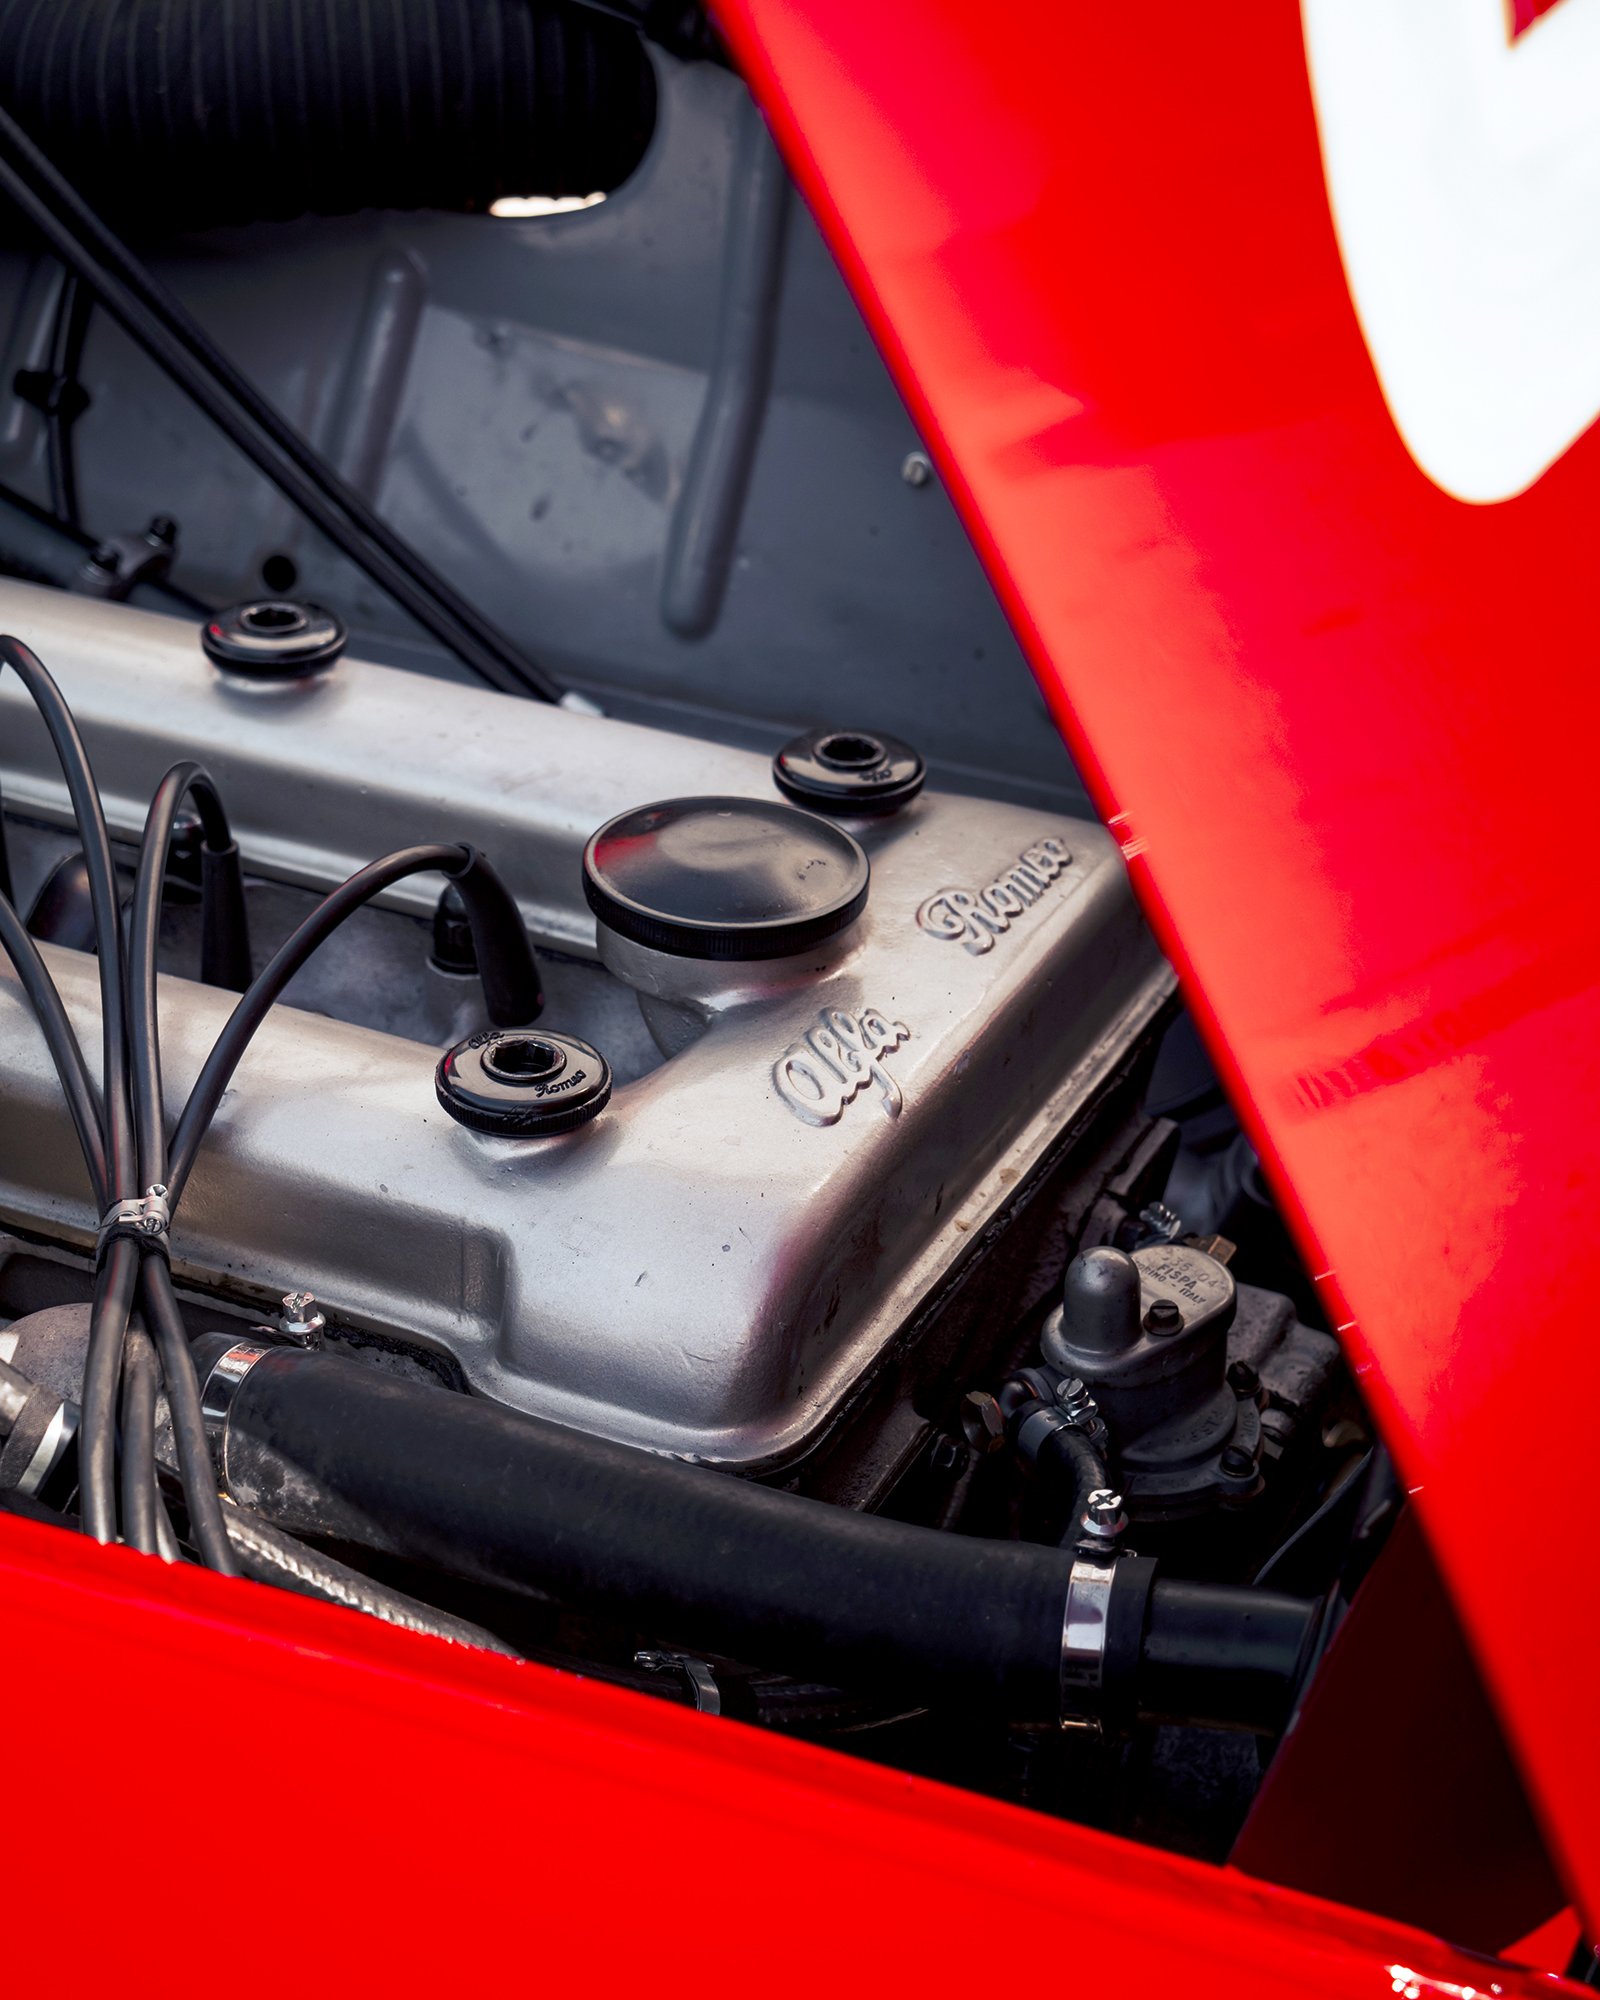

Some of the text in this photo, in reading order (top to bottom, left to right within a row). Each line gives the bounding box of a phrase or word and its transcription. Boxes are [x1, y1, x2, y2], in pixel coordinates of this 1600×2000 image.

[916, 837, 1073, 956] Romeo
[772, 1007, 911, 1127] Alfa
[534, 1069, 587, 1098] Romeo
[1157, 1263, 1198, 1290] FISPA
[1179, 1287, 1207, 1305] ITALY
